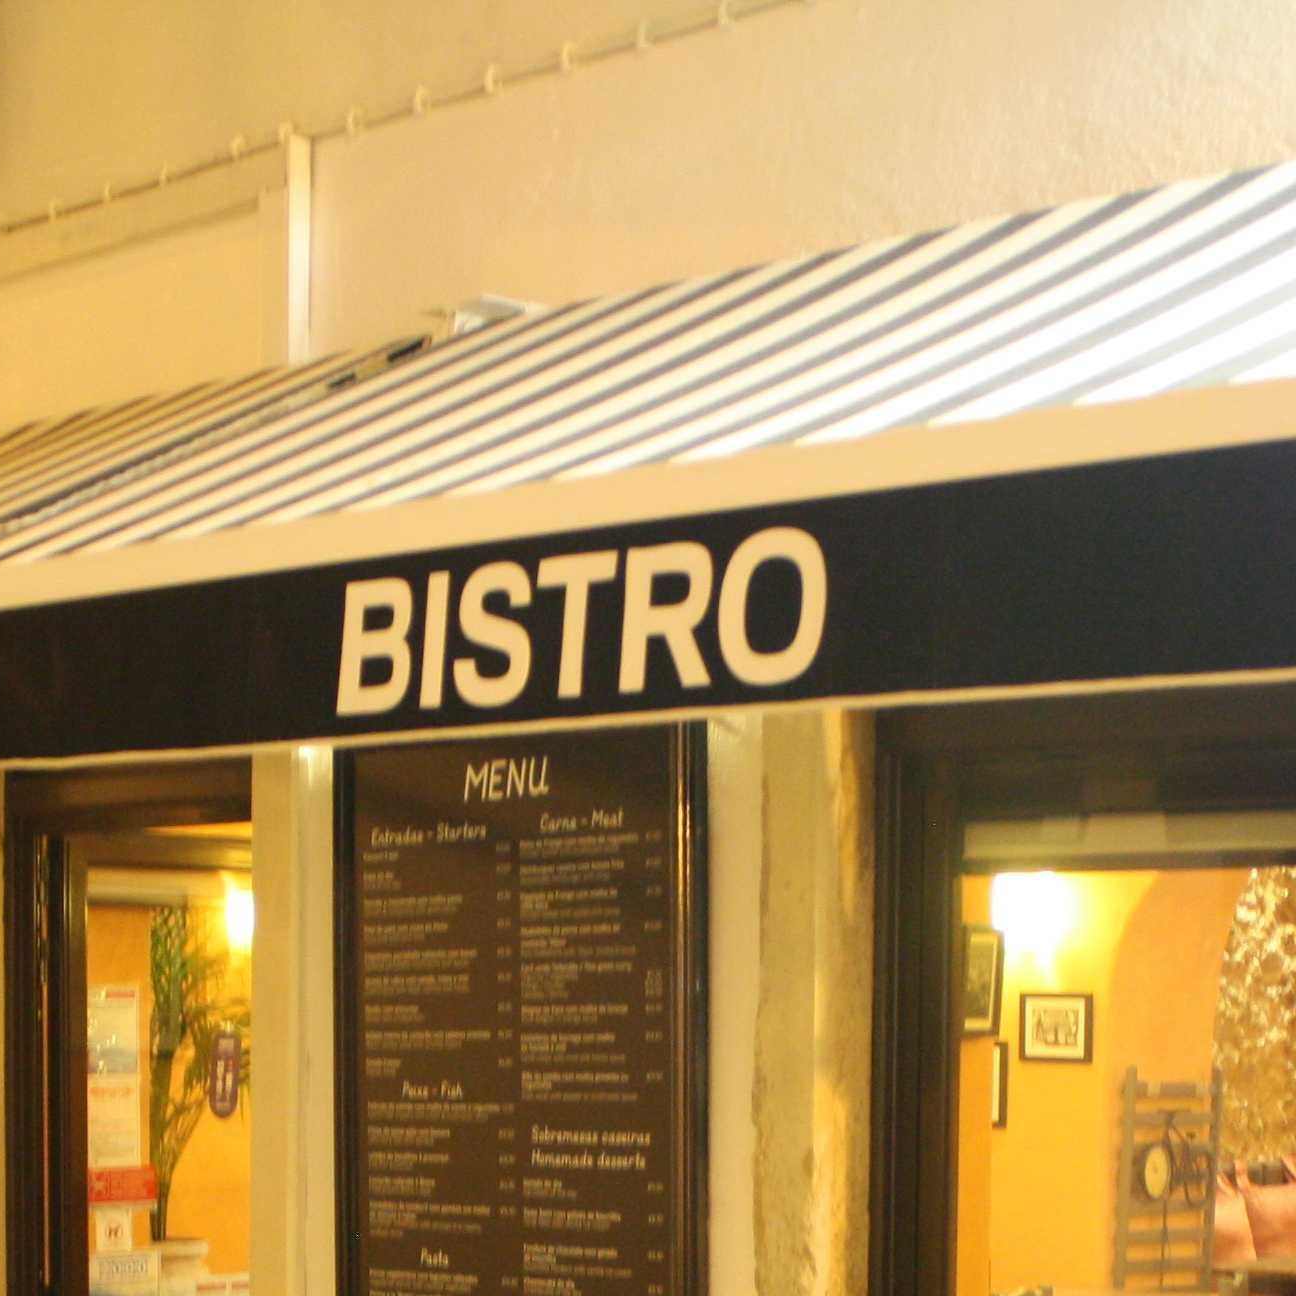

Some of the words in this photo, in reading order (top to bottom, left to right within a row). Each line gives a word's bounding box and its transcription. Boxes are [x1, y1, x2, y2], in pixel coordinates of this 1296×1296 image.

[336, 526, 829, 718] BISTRO
[464, 756, 550, 803] MENU
[436, 821, 488, 843] Starters
[590, 807, 625, 828] Meat
